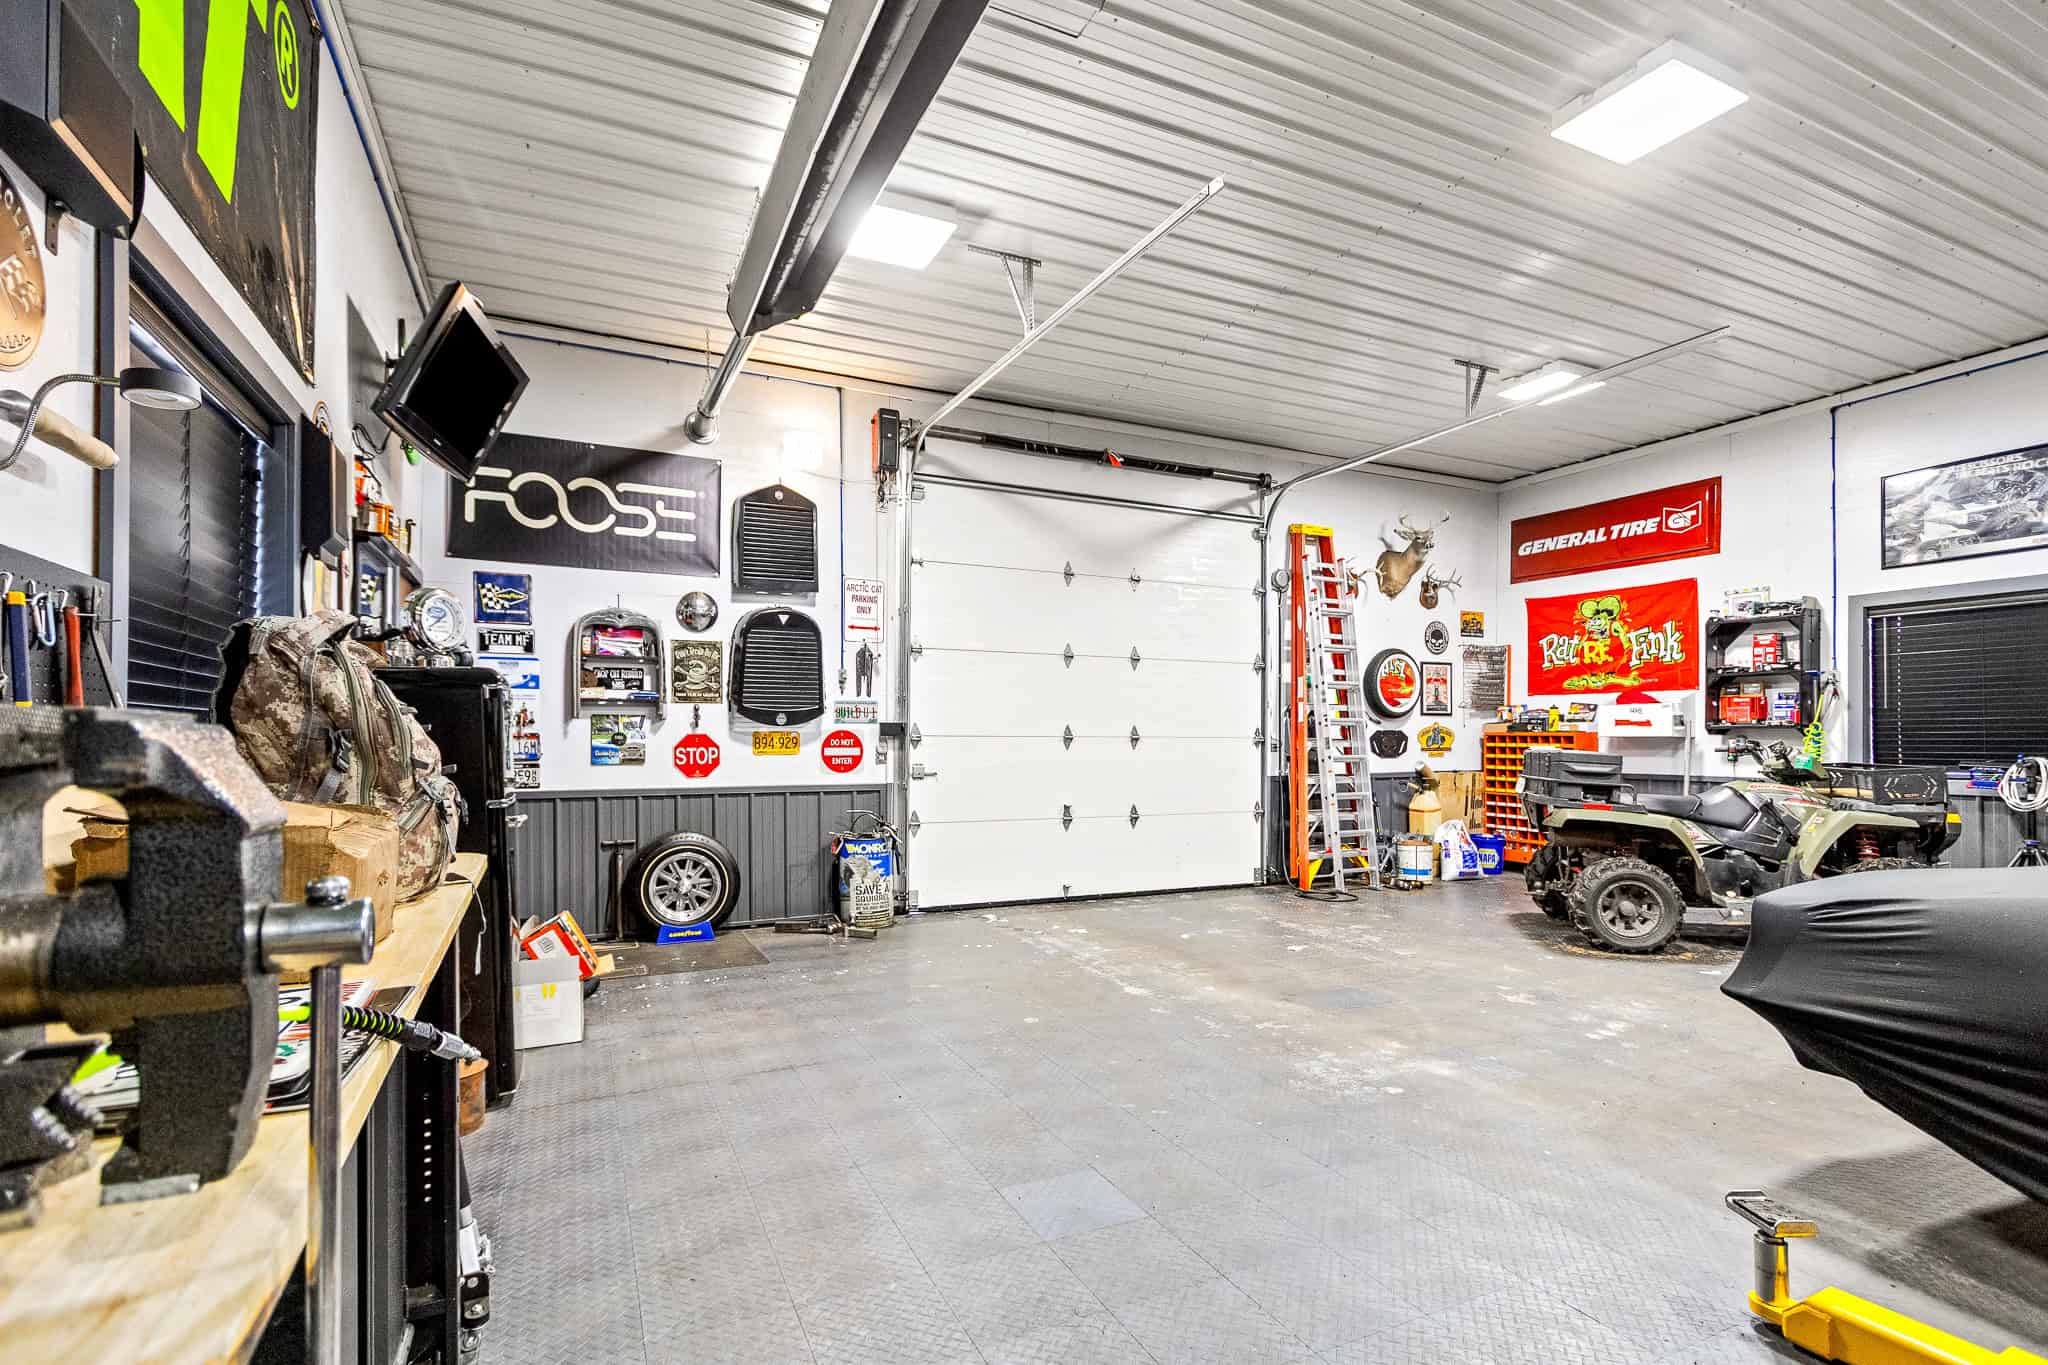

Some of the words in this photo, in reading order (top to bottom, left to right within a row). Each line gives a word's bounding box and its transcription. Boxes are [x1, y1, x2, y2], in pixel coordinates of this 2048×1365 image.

[465, 466, 697, 542] FOOSE
[1518, 530, 1608, 557] GENERAL
[1610, 516, 1661, 541] TIRE
[1667, 509, 1697, 530] GT
[847, 583, 870, 593] ARCTIC
[871, 585, 882, 594] CAT
[851, 594, 878, 604] PARKING
[856, 605, 872, 615] ONLY
[483, 633, 512, 646] TEAM
[1539, 633, 1580, 669] Rat
[1629, 620, 1685, 669] Fink
[830, 738, 840, 747] DO
[675, 747, 719, 765] STOP
[831, 756, 853, 766] ENTER
[1478, 851, 1497, 865] NAPA
[855, 884, 882, 896] SAVE
